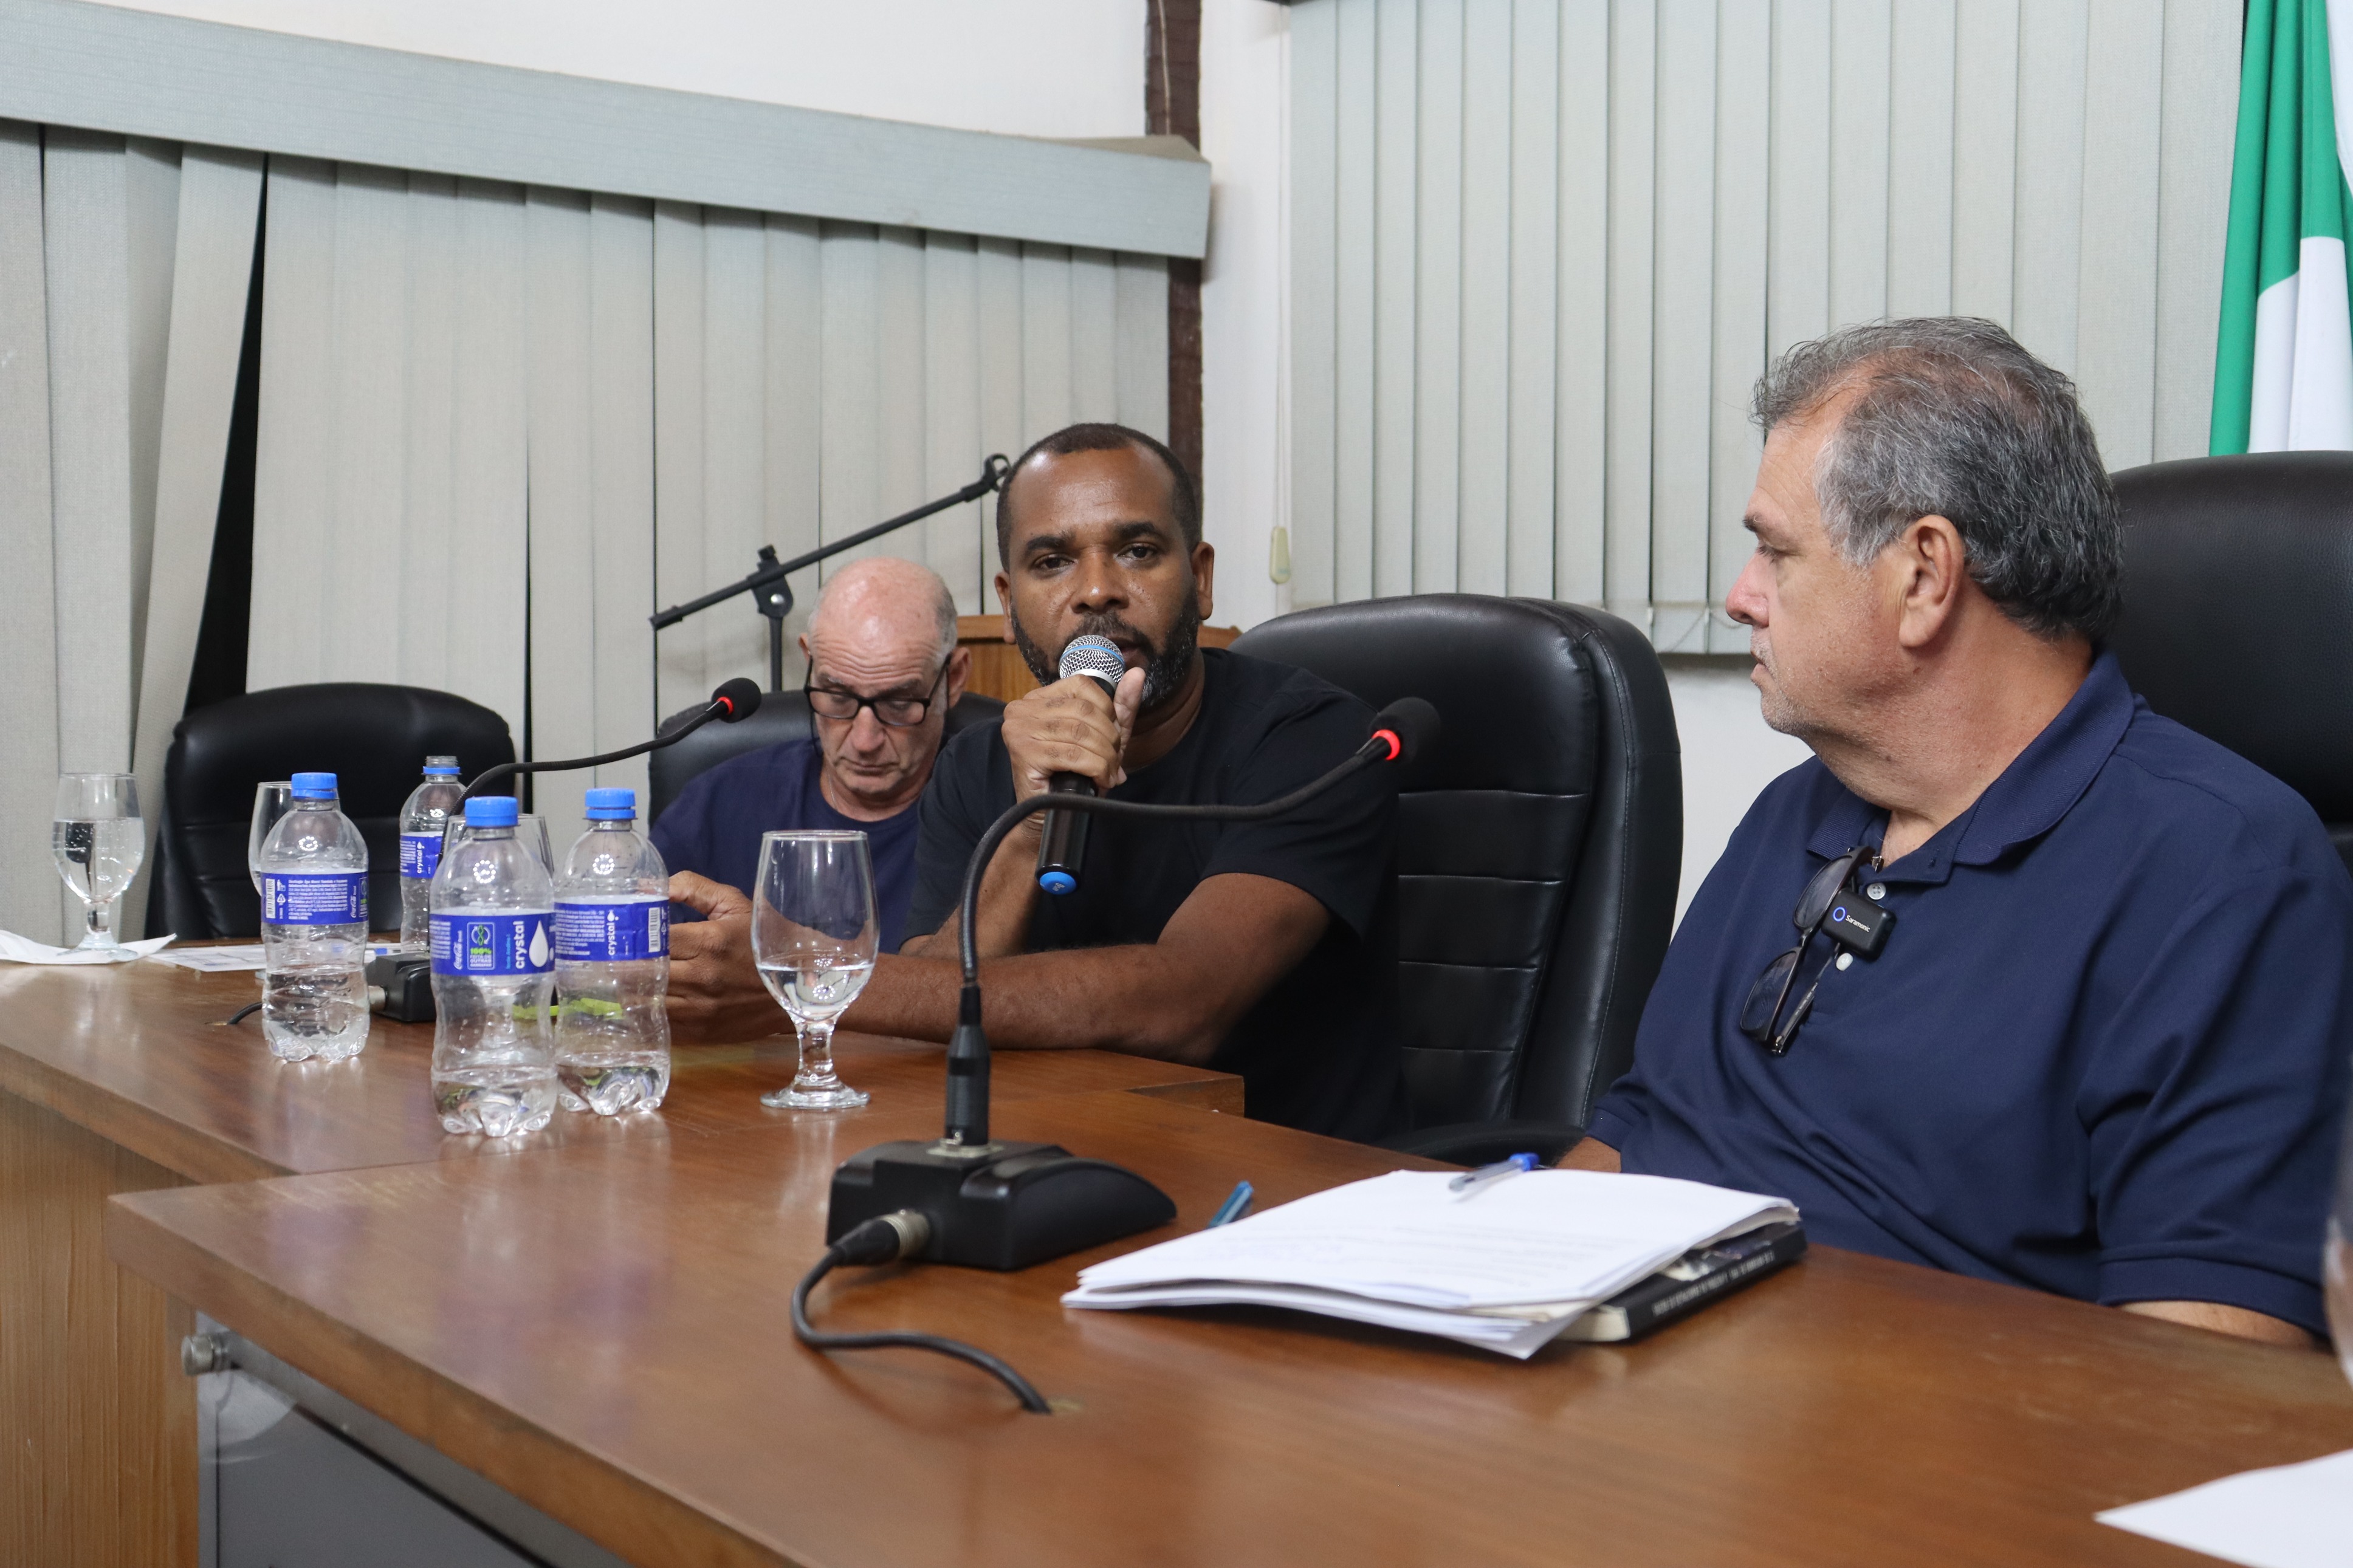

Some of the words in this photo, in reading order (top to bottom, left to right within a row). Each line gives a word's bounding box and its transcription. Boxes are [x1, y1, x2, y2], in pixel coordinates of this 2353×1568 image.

[606, 922, 617, 956] crystal
[1845, 914, 1870, 933] Saramonic
[513, 920, 527, 969] crystal
